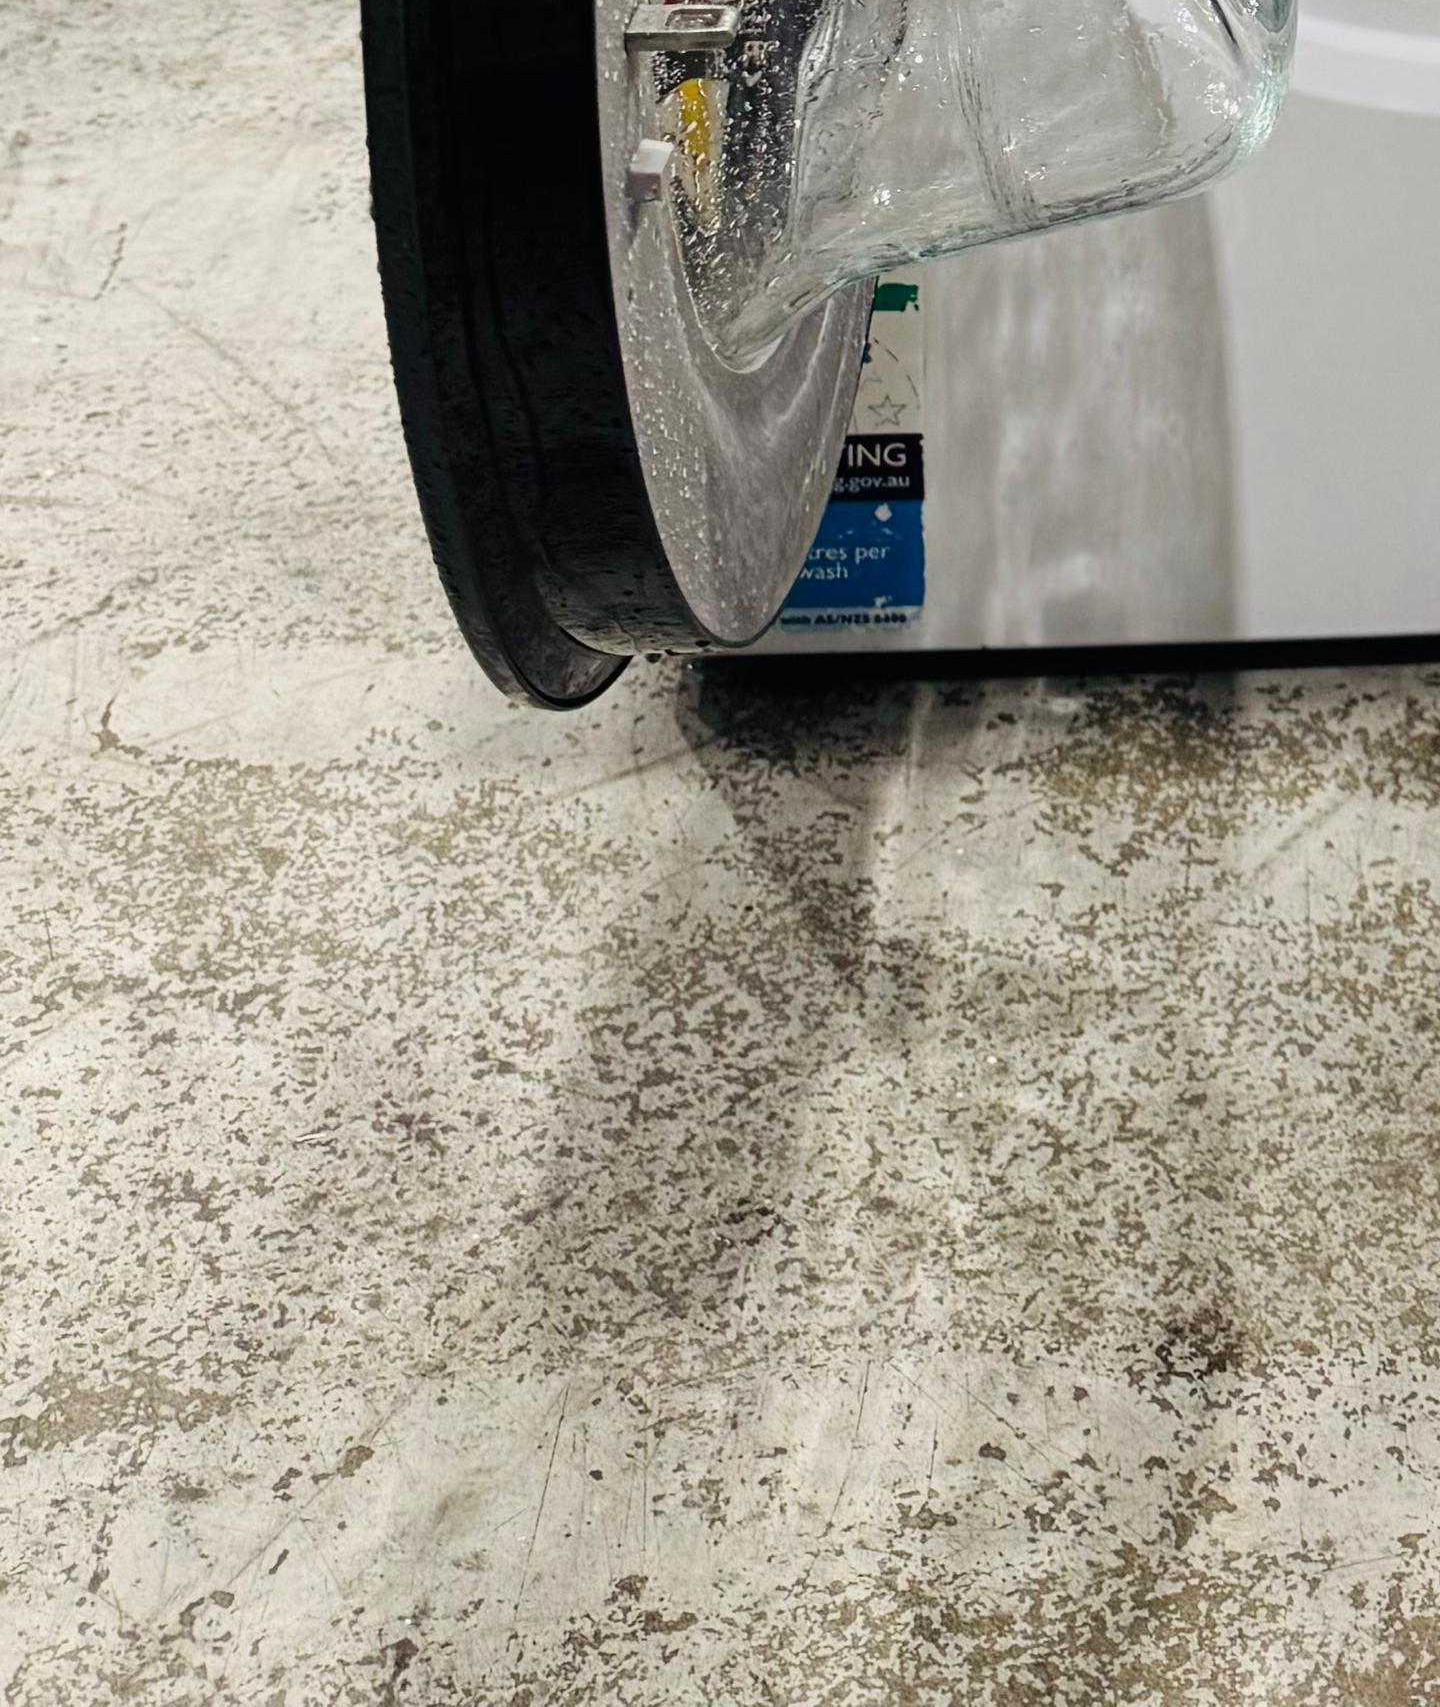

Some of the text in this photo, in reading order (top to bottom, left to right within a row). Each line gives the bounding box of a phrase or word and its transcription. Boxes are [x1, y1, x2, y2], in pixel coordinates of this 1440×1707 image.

[843, 442, 907, 468] ING
[834, 474, 911, 493] g.gov.au
[809, 545, 890, 564] tres per
